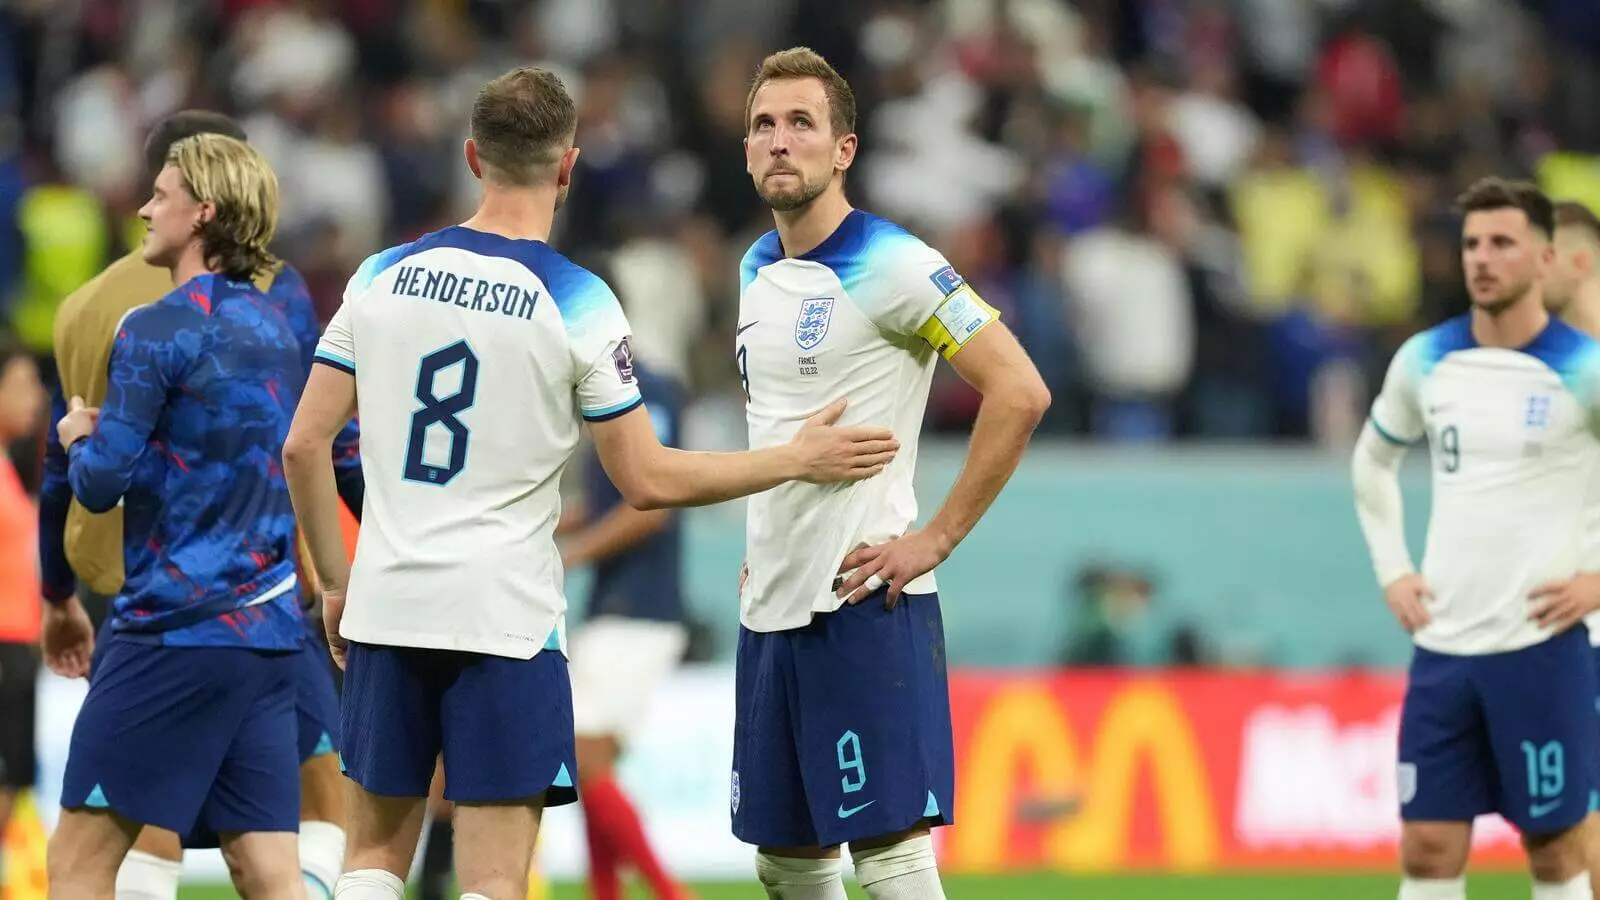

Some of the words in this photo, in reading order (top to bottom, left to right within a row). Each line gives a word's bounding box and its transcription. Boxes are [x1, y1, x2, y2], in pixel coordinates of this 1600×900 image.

[392, 266, 539, 320] HENDERSON
[402, 337, 480, 488] 8
[836, 729, 867, 794] 9
[1520, 739, 1565, 797] 19
